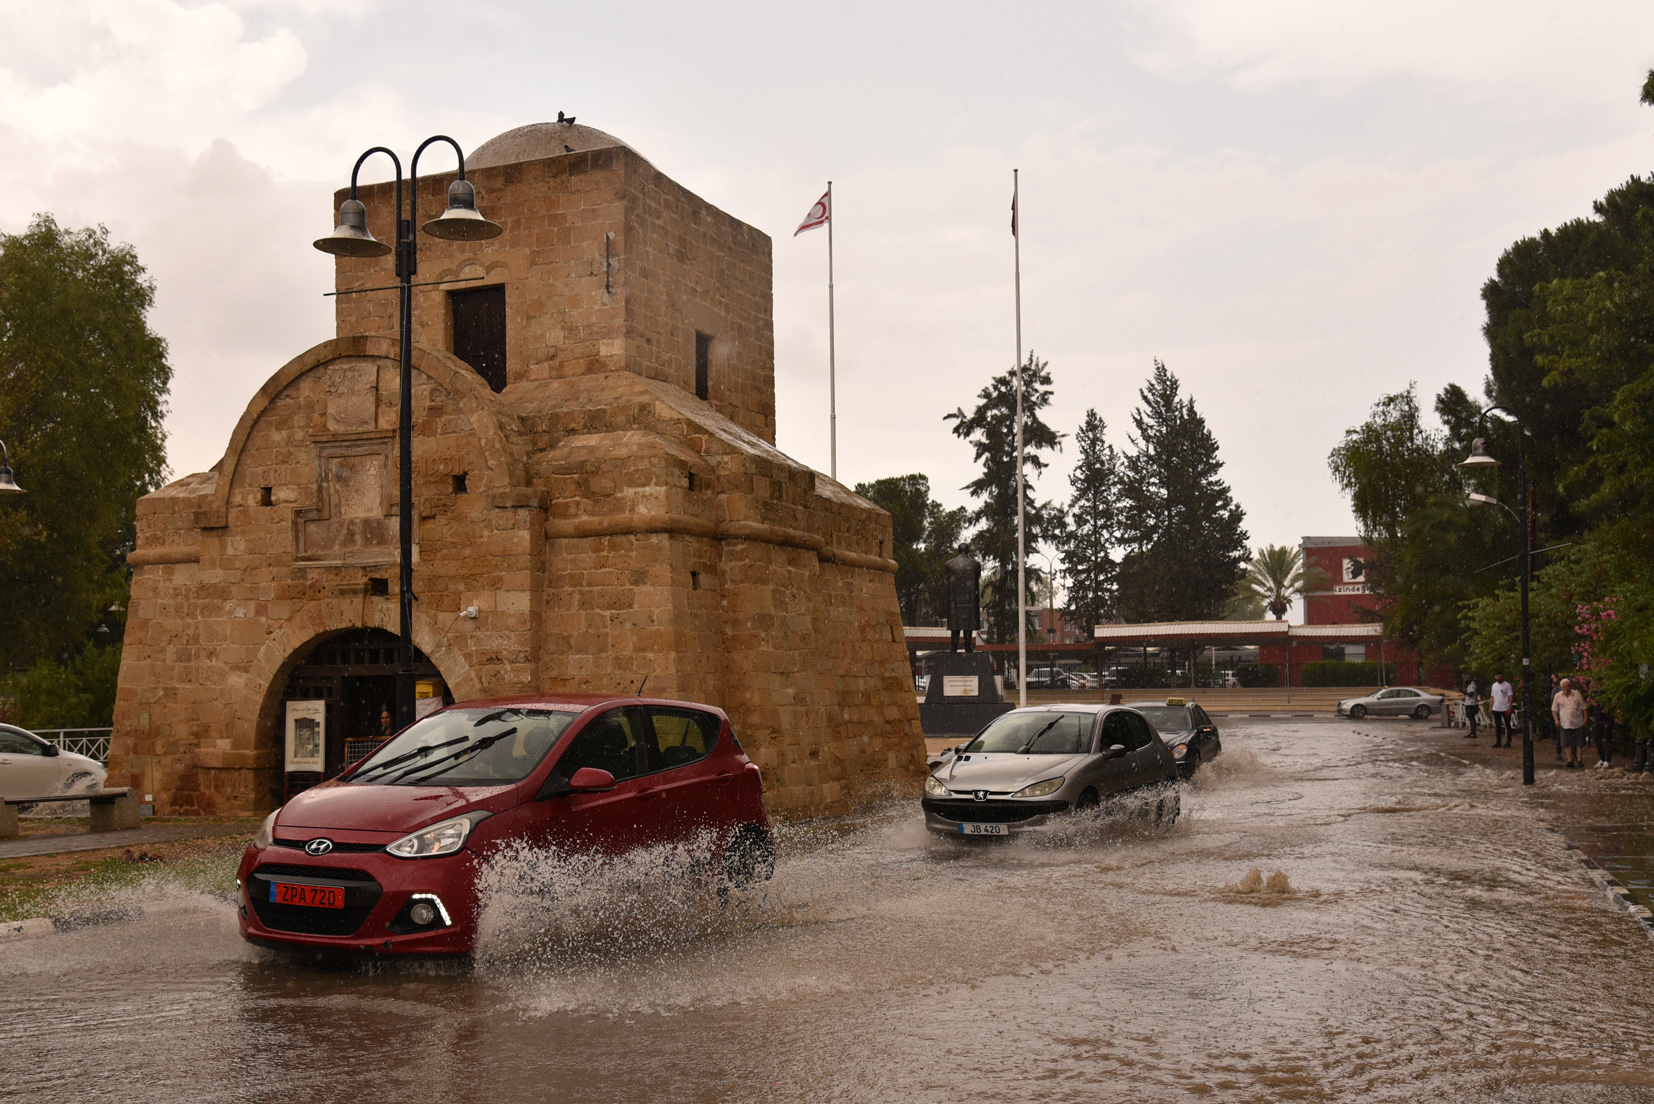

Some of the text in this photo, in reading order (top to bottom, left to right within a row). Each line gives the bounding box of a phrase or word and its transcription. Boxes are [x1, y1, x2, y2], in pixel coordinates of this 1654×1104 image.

[970, 824, 1001, 834] JB 420
[282, 885, 336, 906] ZPA 720
